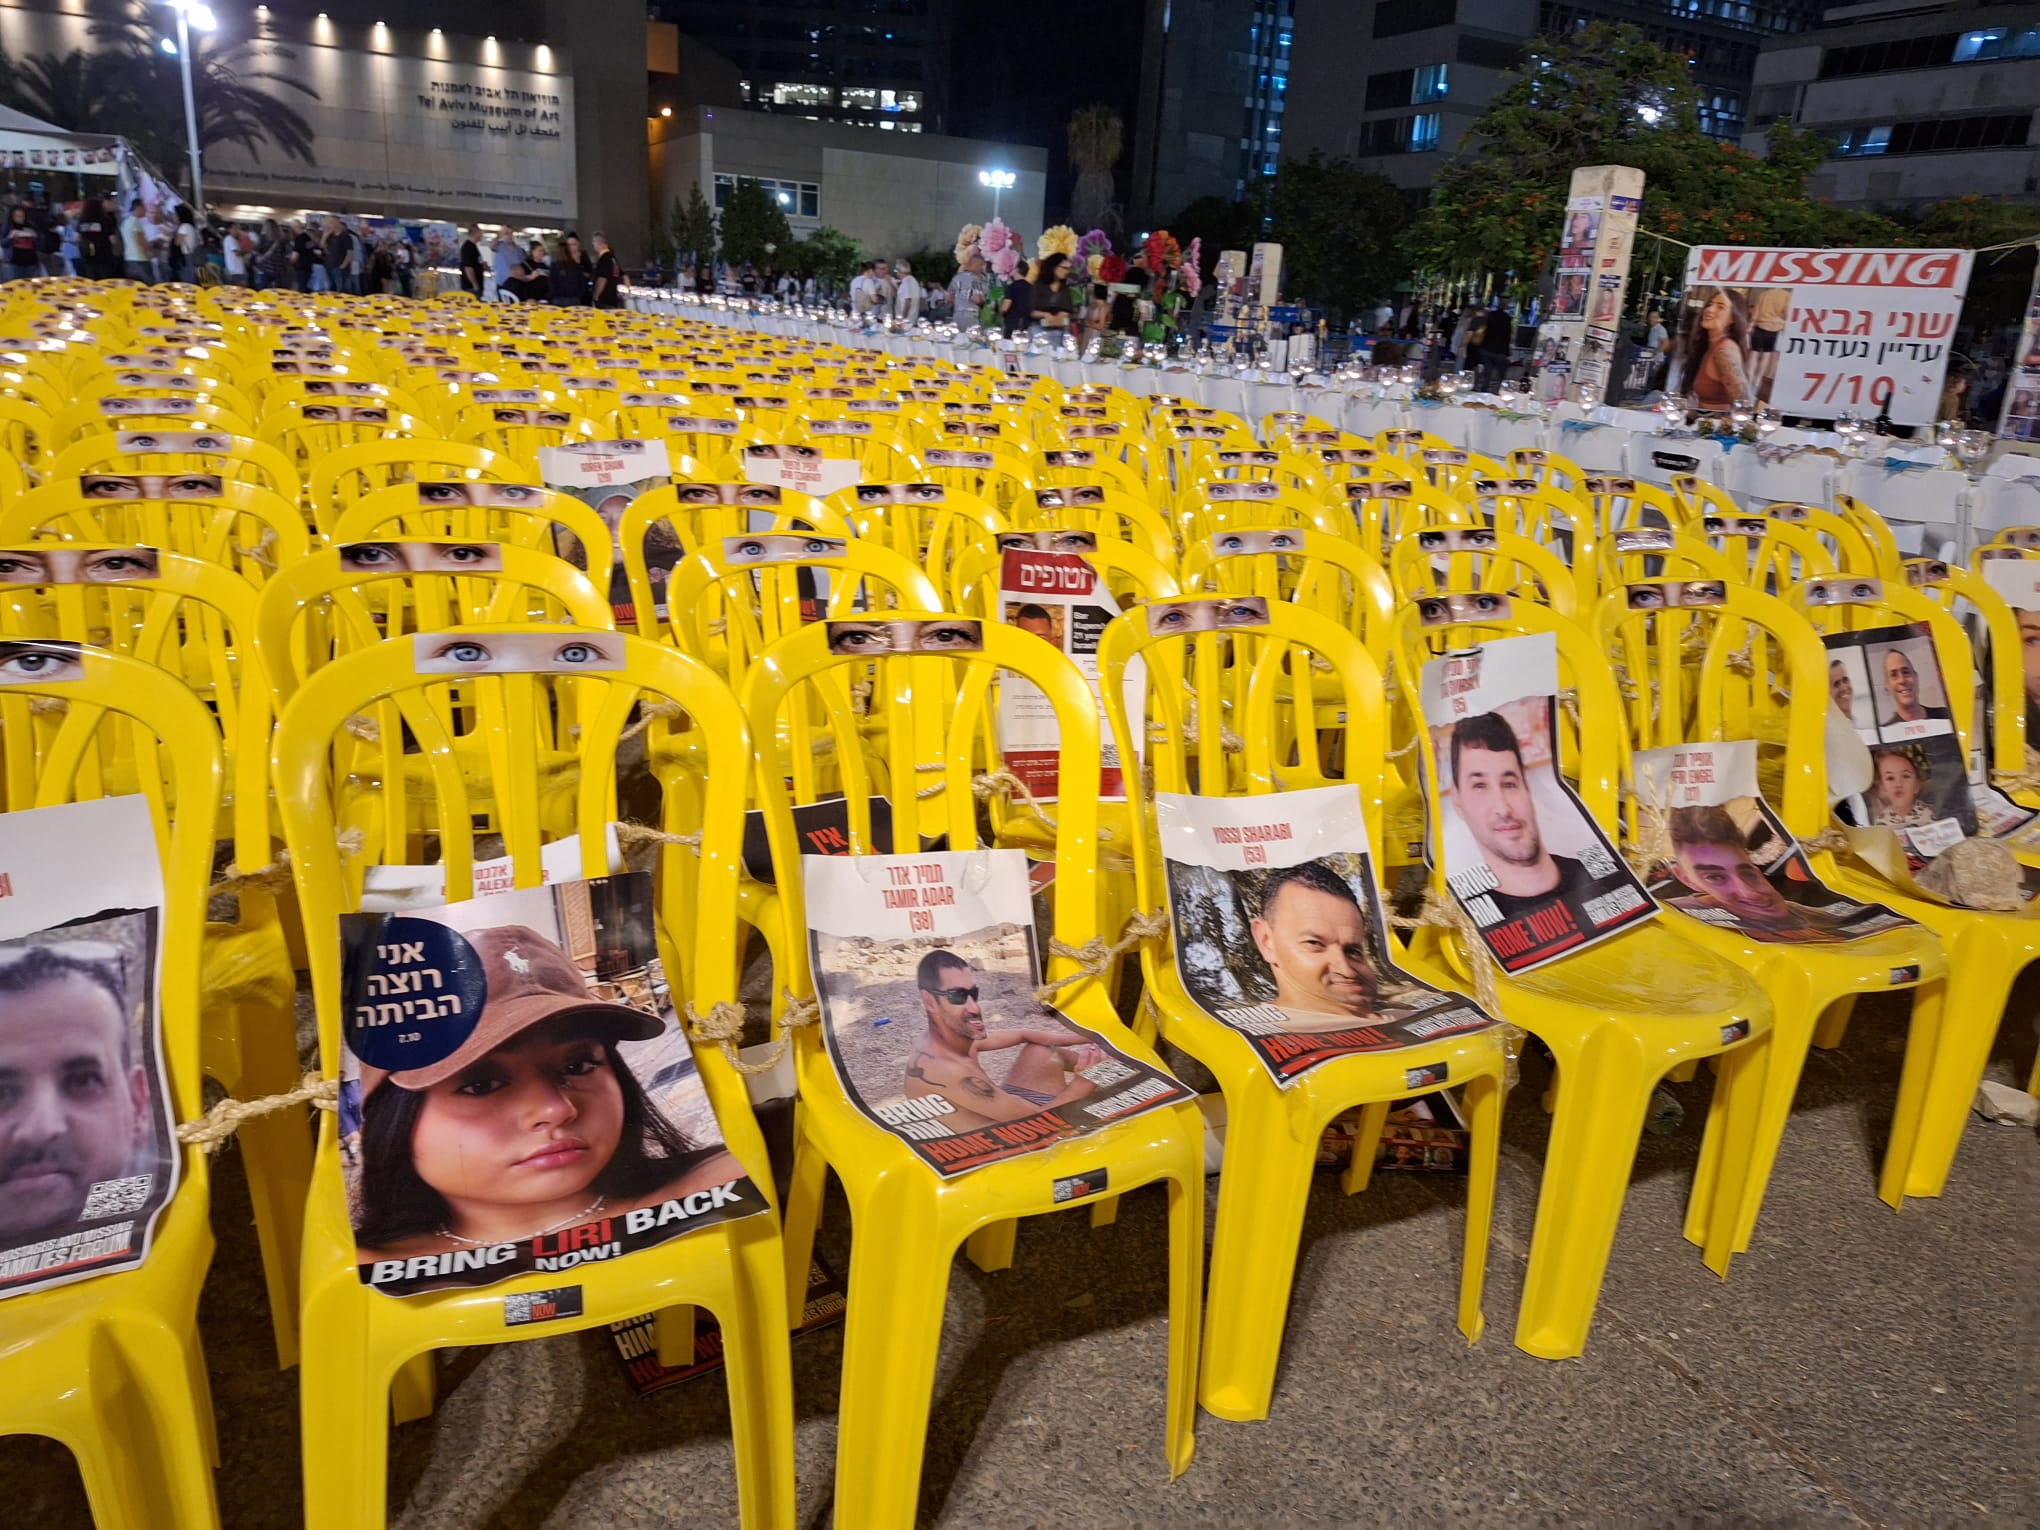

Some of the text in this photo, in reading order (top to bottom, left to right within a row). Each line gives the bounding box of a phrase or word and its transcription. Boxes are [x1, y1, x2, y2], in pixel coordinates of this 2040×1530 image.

[431, 81, 472, 94] לאמנות
[475, 86, 501, 99] אביב
[504, 88, 520, 99] תל
[417, 95, 560, 121] Tel Aviv Museum of Art
[1701, 252, 1953, 285] MISSING
[1791, 307, 1954, 339] שני גבאי
[1786, 338, 1943, 365] עדיין נעדרת
[1801, 373, 1896, 406] 7/10
[1212, 822, 1293, 844] YOSSI SHARABI
[1242, 843, 1267, 865] (53)
[886, 863, 944, 886] תמיר אדר
[1446, 864, 1502, 900] BRING
[882, 885, 955, 909] TAMIR ADAR
[1461, 893, 1506, 928] HIM
[909, 909, 935, 933] (38)
[1484, 899, 1578, 959] HOME NOW!
[377, 941, 426, 965] אני
[367, 968, 443, 997] רוצה
[356, 994, 462, 1028] הביתה
[1214, 1003, 1291, 1024] BRING
[1260, 1034, 1333, 1063] HOME
[871, 1094, 958, 1126] BRING
[893, 1120, 957, 1140] HIM
[921, 1110, 1073, 1164] HOME NOW!
[371, 1180, 743, 1284] BRING LIRI BACK
[535, 1242, 622, 1272] NOW!
[531, 1302, 556, 1318] NOW
